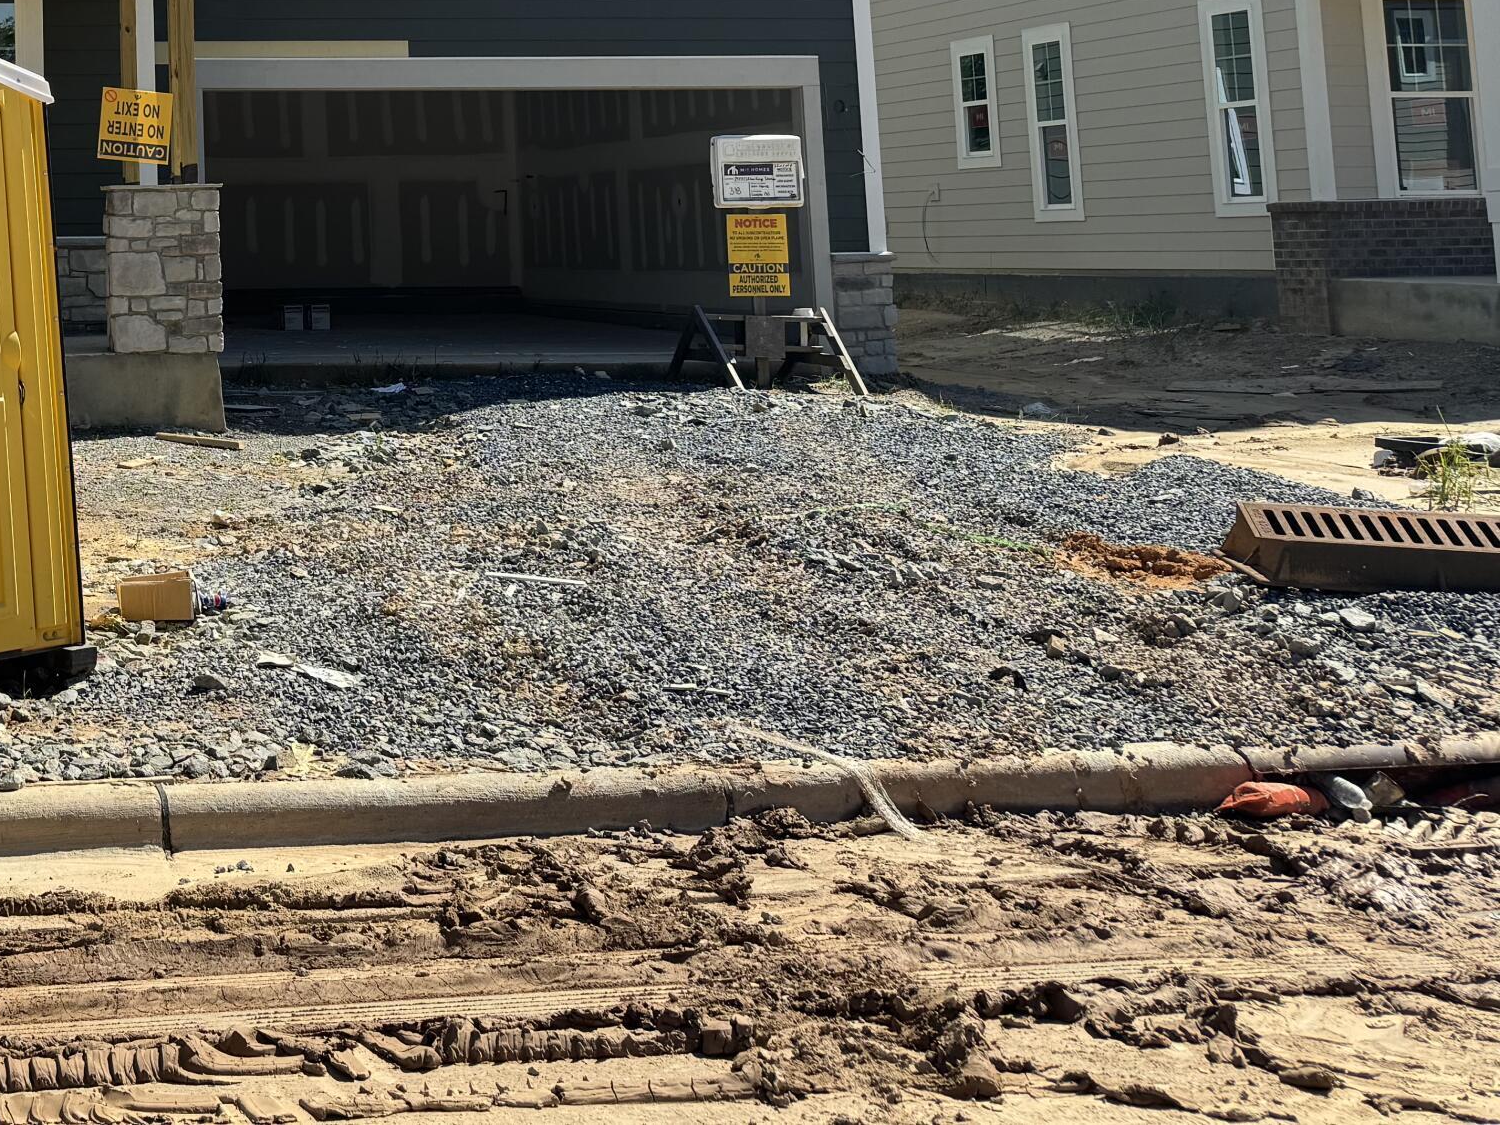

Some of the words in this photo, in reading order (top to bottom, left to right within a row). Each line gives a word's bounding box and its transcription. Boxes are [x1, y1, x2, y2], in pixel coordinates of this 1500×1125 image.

[114, 100, 140, 117] EXIT
[143, 103, 161, 119] NO
[106, 119, 143, 137] ENTER
[147, 124, 164, 139] NO
[102, 141, 164, 158] CAUTION
[734, 218, 778, 229] NOTICE
[733, 263, 784, 273] CAUTION
[739, 275, 779, 284] AUTHORIZED
[732, 284, 769, 294] PERSONNEL
[769, 284, 787, 293] ONLY
